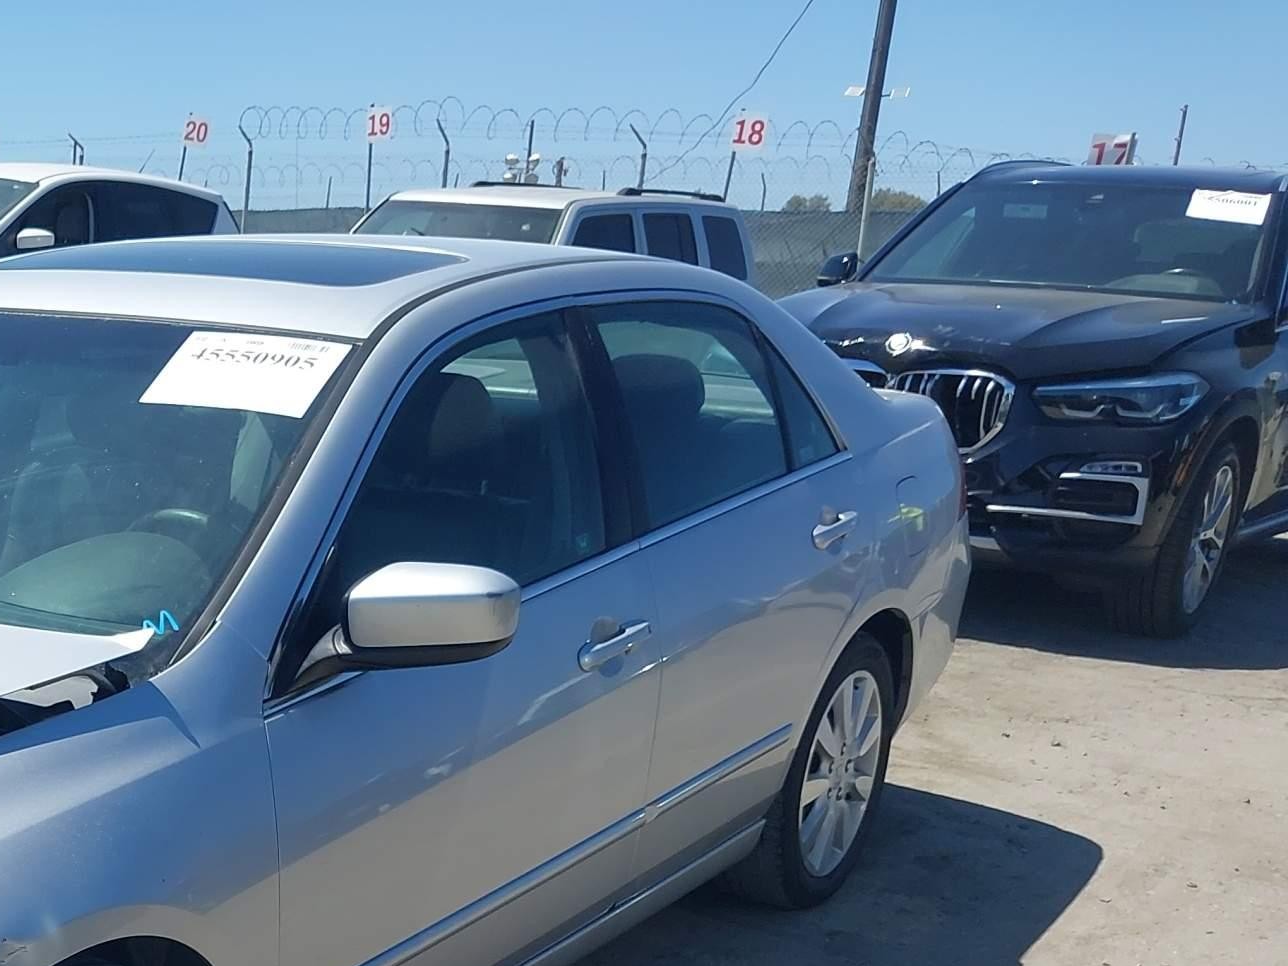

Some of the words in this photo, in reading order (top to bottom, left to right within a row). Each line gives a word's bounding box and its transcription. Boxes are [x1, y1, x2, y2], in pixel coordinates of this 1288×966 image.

[184, 121, 208, 143] 20
[367, 113, 391, 137] 19
[732, 118, 765, 146] 18
[1092, 142, 1128, 165] 17
[191, 347, 318, 370] 45550905
